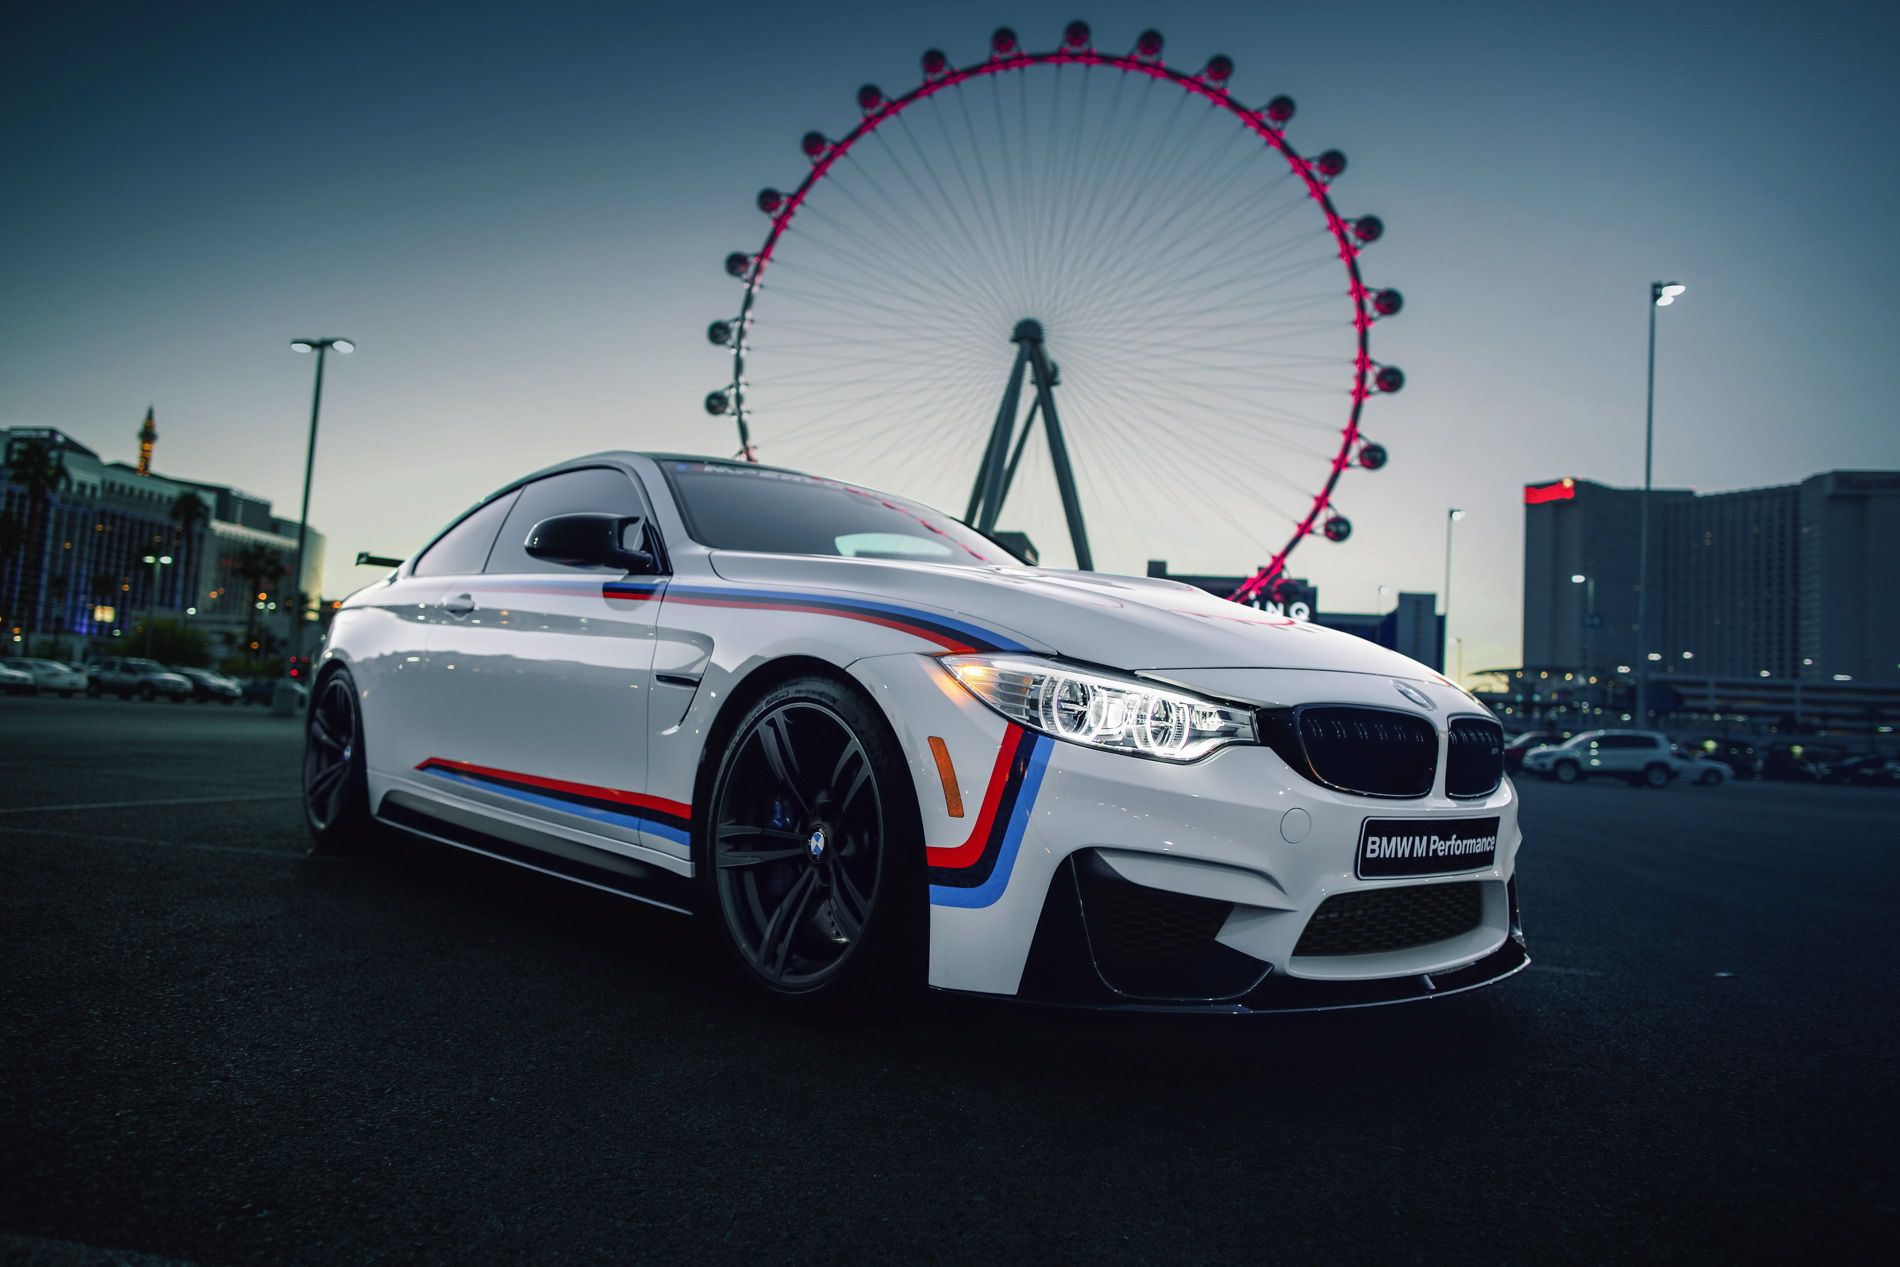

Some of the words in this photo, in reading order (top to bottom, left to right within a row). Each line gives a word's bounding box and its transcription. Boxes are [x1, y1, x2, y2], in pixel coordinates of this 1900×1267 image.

[1366, 836, 1413, 858] BMW
[1413, 836, 1428, 858] M
[1429, 834, 1496, 857] Performance
